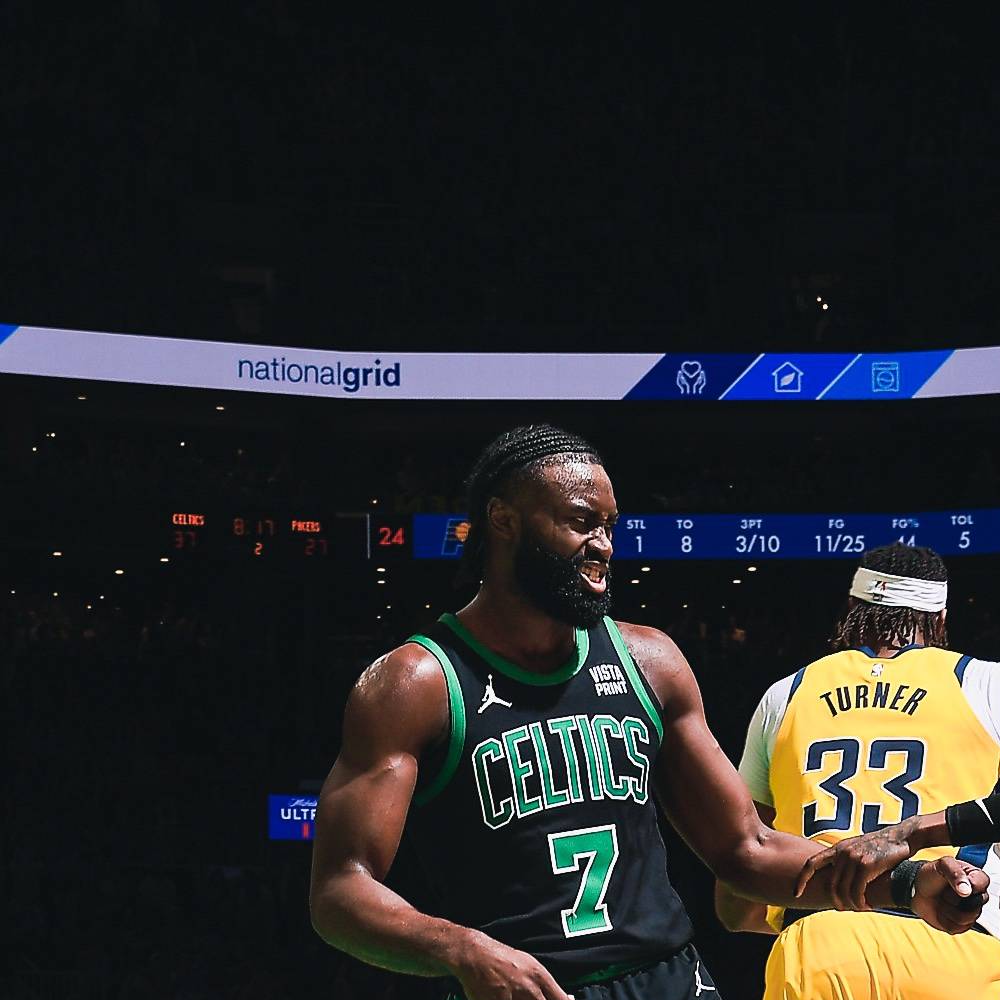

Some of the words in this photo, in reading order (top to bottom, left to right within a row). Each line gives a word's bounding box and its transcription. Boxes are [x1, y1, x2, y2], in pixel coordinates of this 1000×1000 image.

[238, 357, 401, 393] nationalgrid
[626, 519, 647, 530] STL
[676, 519, 694, 530] TO
[740, 519, 763, 530] 3PT
[828, 518, 845, 529] FG
[892, 518, 920, 529] FG%
[950, 514, 974, 526] TOL
[377, 526, 406, 546] 24
[635, 535, 644, 553] 1
[680, 535, 693, 553] 8
[735, 534, 780, 553] 3/10
[815, 534, 866, 553] 11/25
[958, 531, 971, 549] 5
[253, 541, 264, 556] 2
[589, 664, 624, 683] VISTA
[595, 680, 628, 698] PRINT
[819, 682, 928, 717] TURNER
[471, 714, 650, 830] CELTICS
[801, 736, 927, 838] 33
[280, 808, 317, 820] ULT
[547, 824, 619, 938] 7
